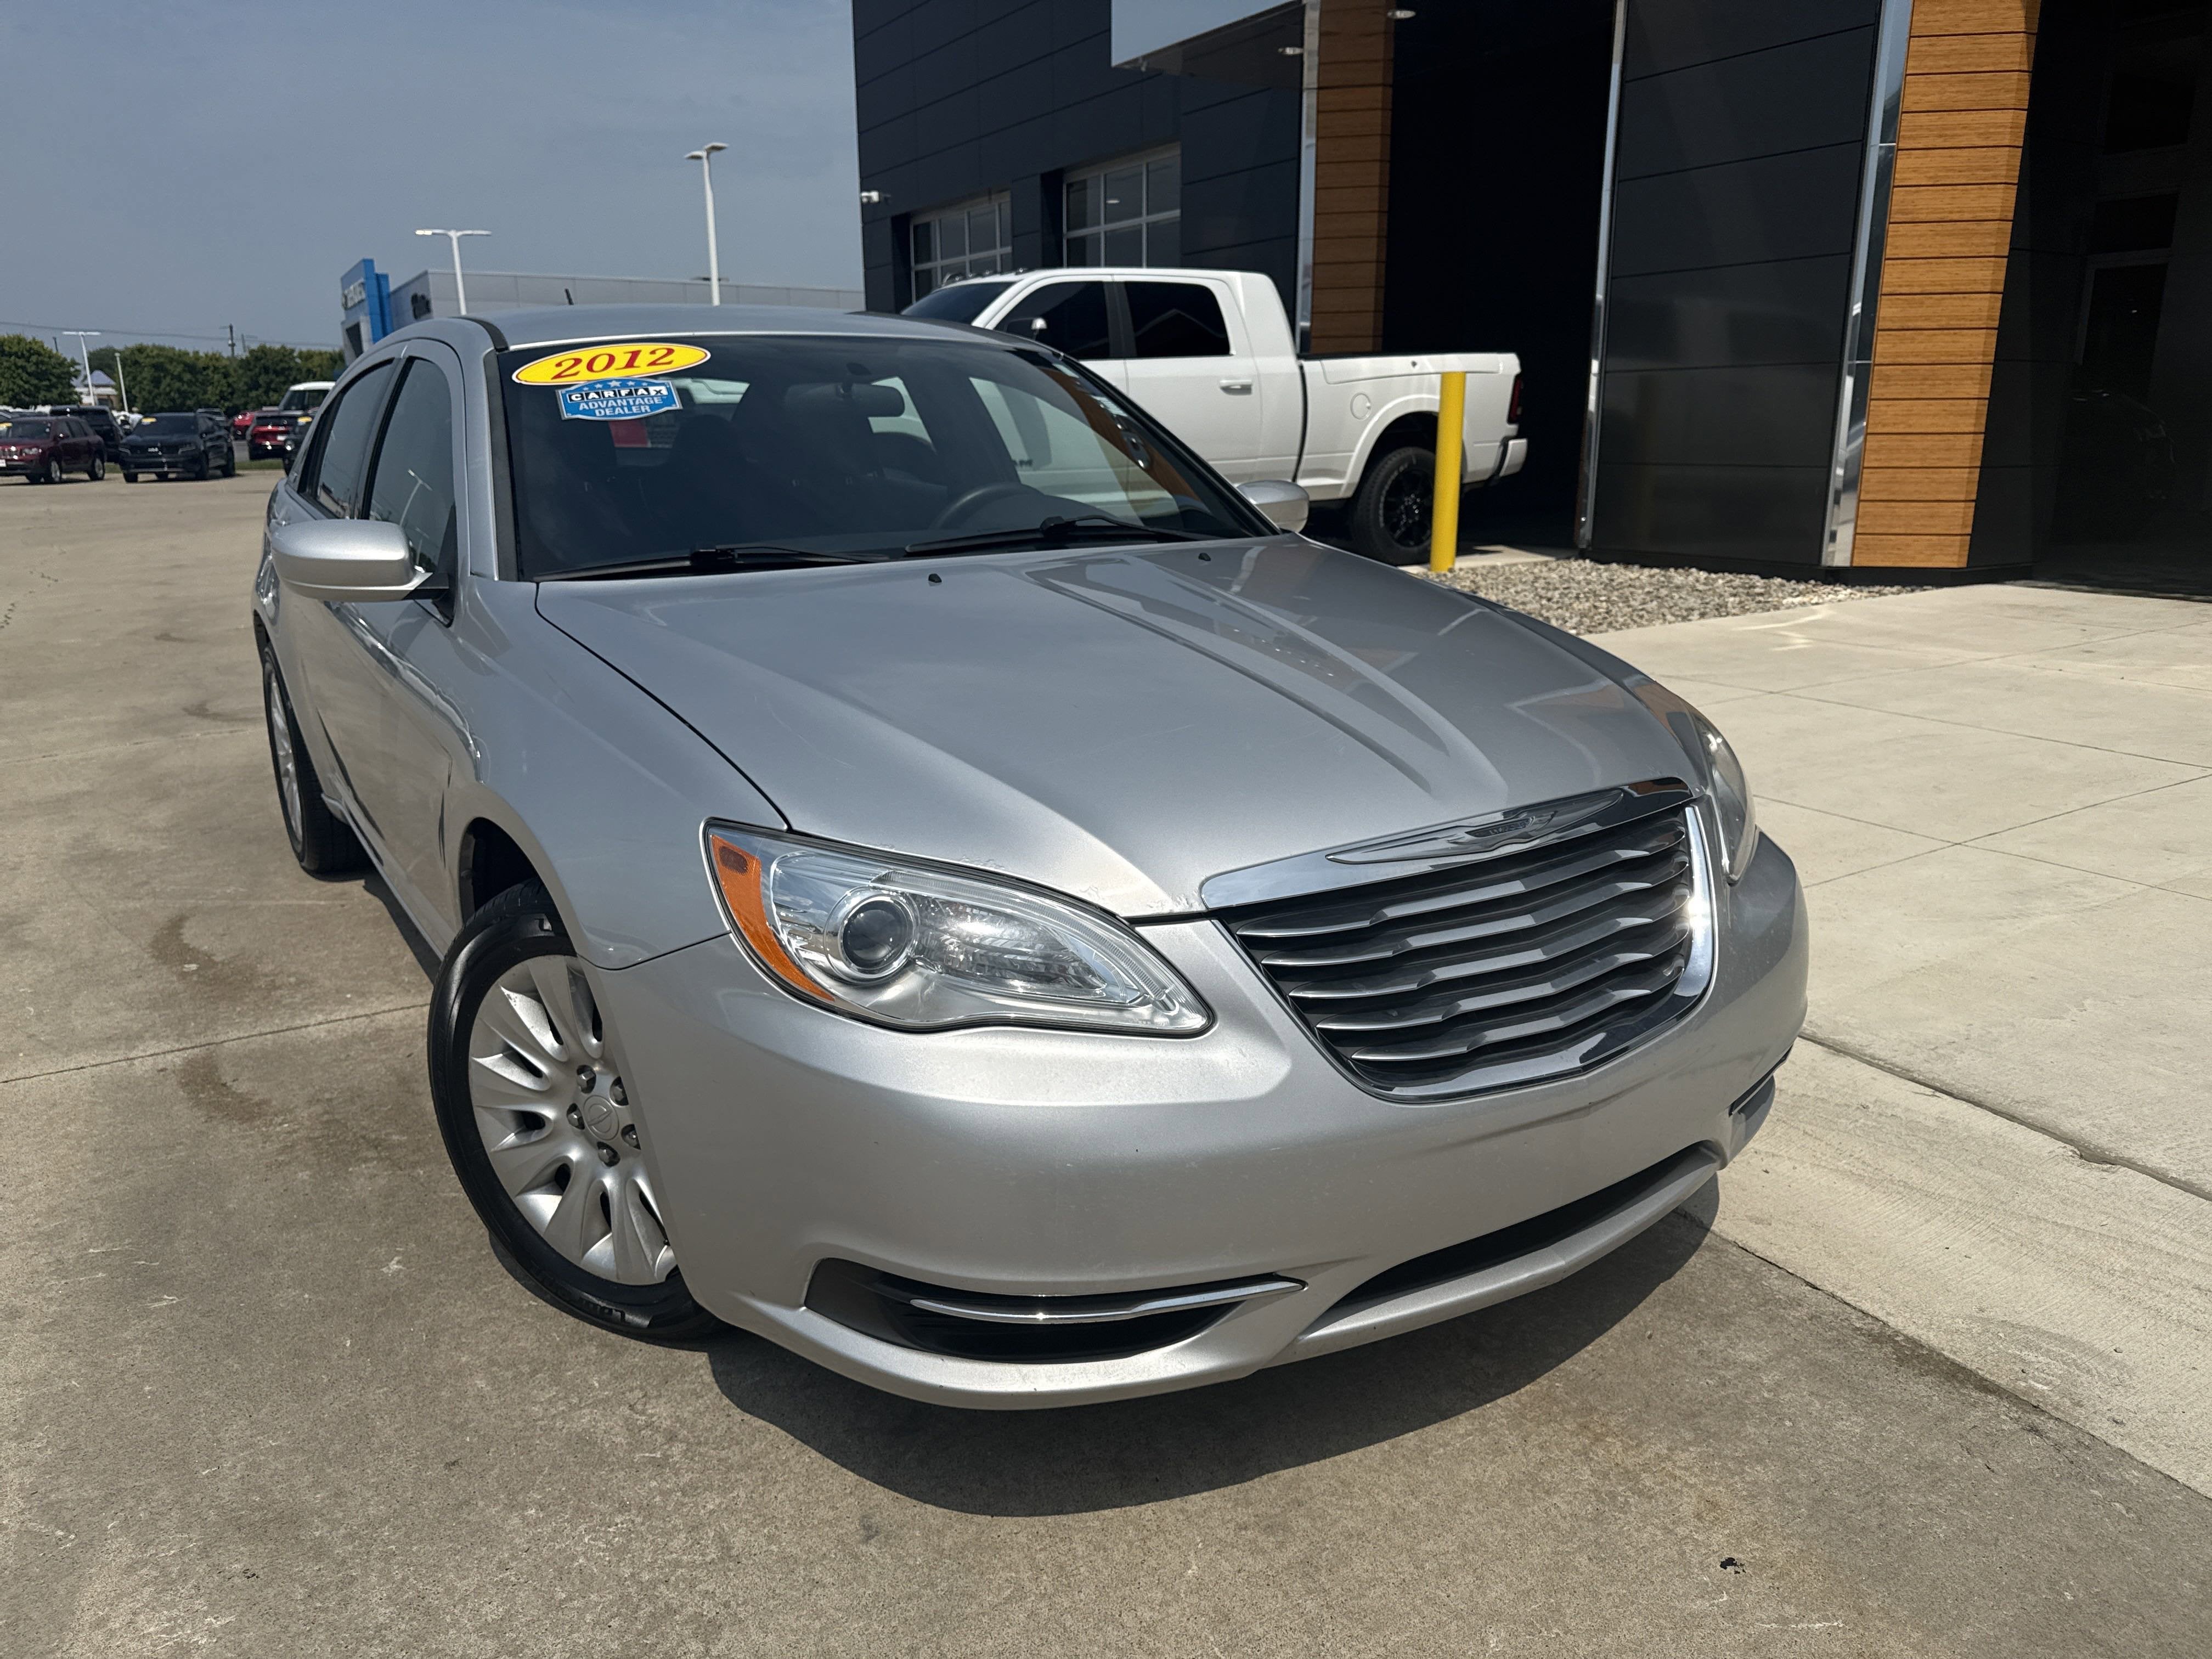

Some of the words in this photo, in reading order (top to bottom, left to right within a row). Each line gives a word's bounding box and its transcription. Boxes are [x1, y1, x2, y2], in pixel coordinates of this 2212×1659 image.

[551, 348, 675, 380] 2012
[571, 387, 664, 401] CARFAX
[579, 397, 663, 410] ADVANTAGE
[594, 405, 651, 416] DEALER
